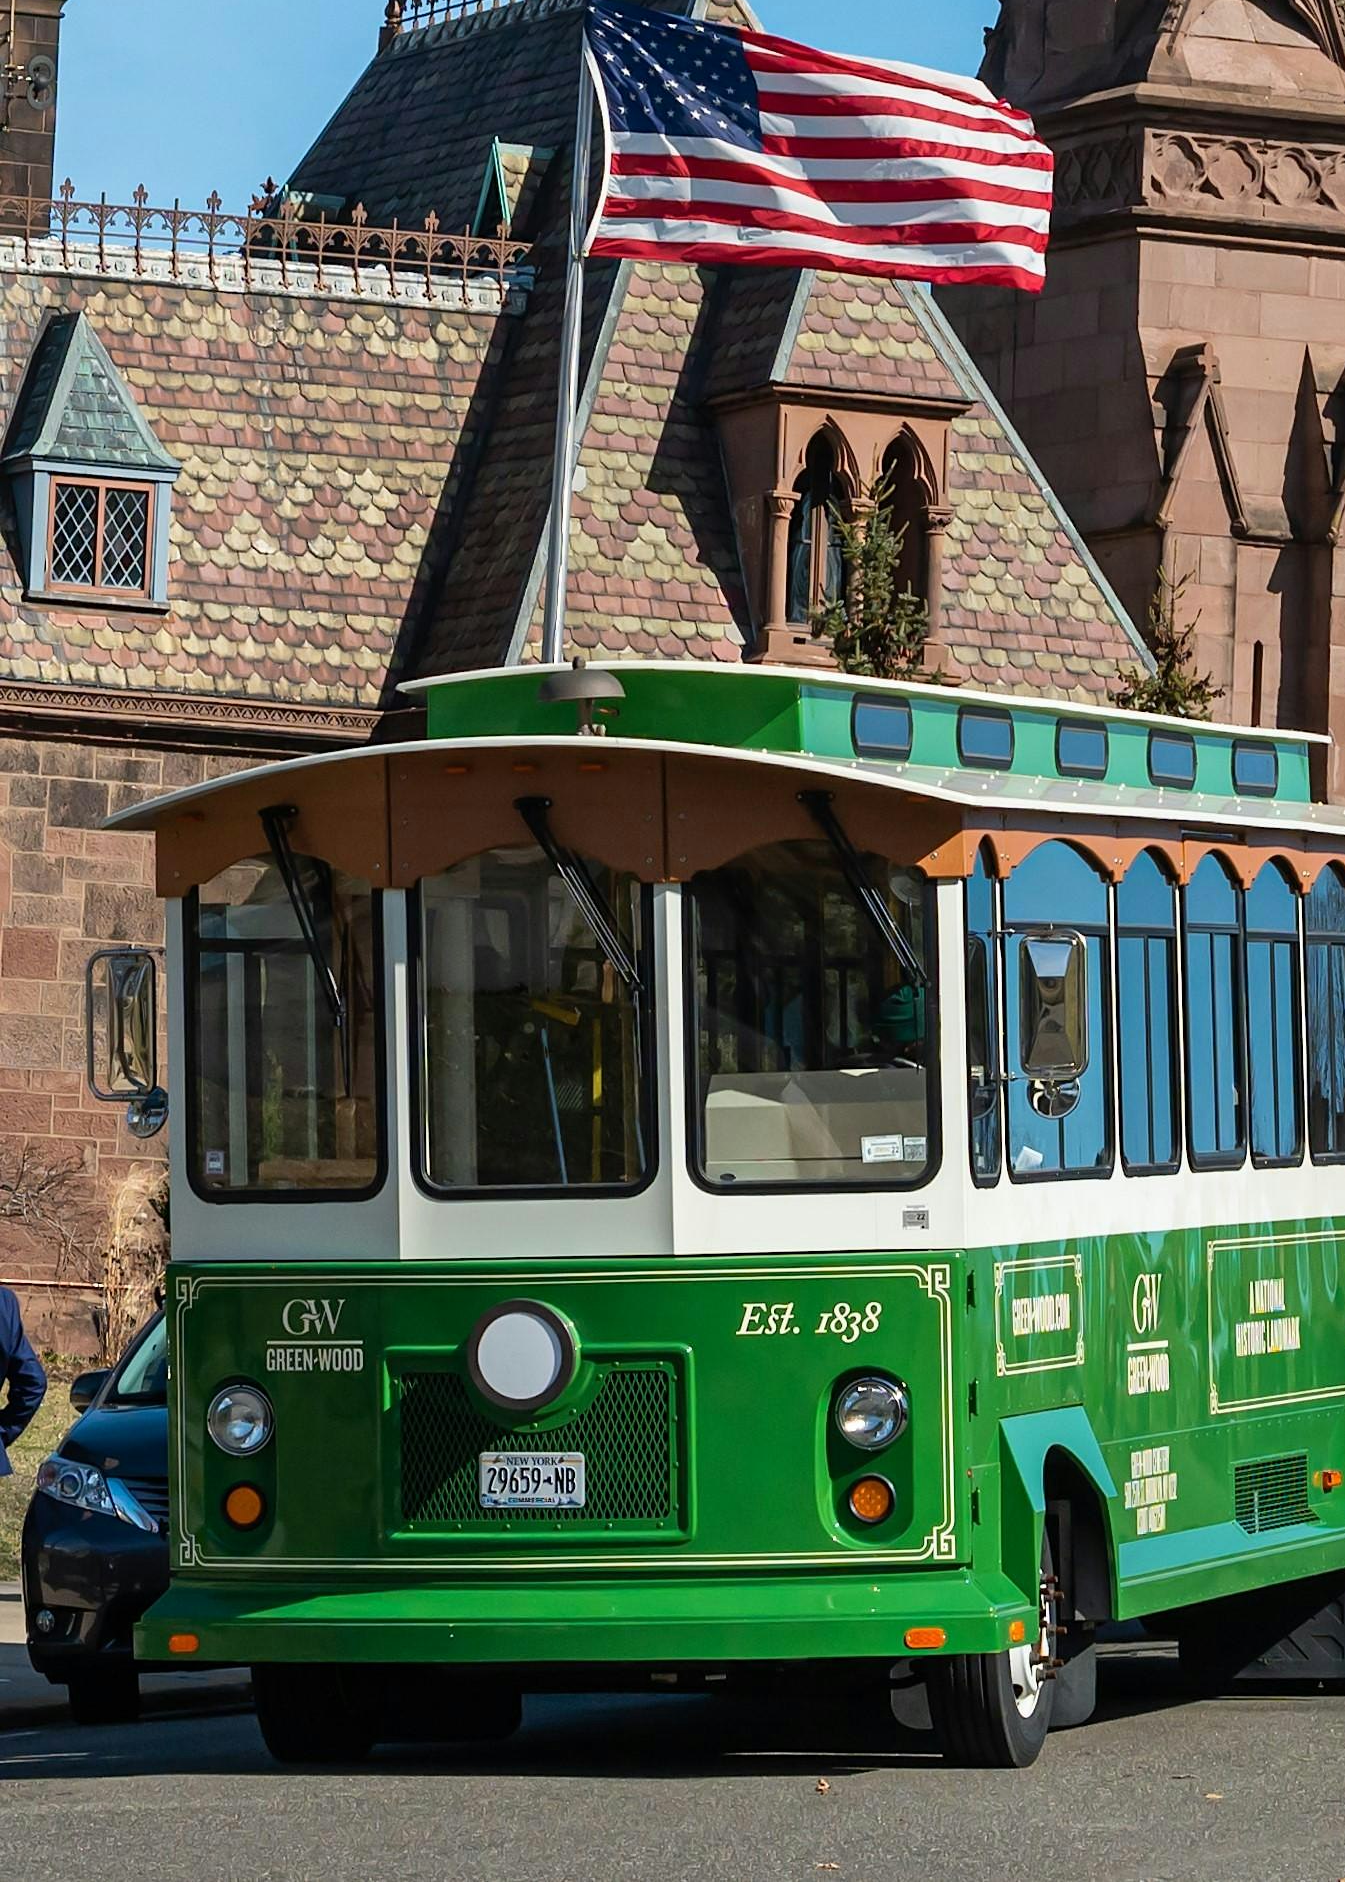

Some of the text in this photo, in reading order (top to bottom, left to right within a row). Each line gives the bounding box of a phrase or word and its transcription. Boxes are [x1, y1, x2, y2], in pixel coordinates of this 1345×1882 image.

[282, 1299, 346, 1335] GW
[736, 1301, 882, 1343] Est. 1838
[1012, 1293, 1071, 1336] GREEN-WOOD.COM
[1133, 1273, 1162, 1334] GW
[267, 1348, 364, 1371] GREEN-WOOD
[1127, 1353, 1170, 1396] GREEN-WOOD
[507, 1457, 557, 1465] NEW YORK
